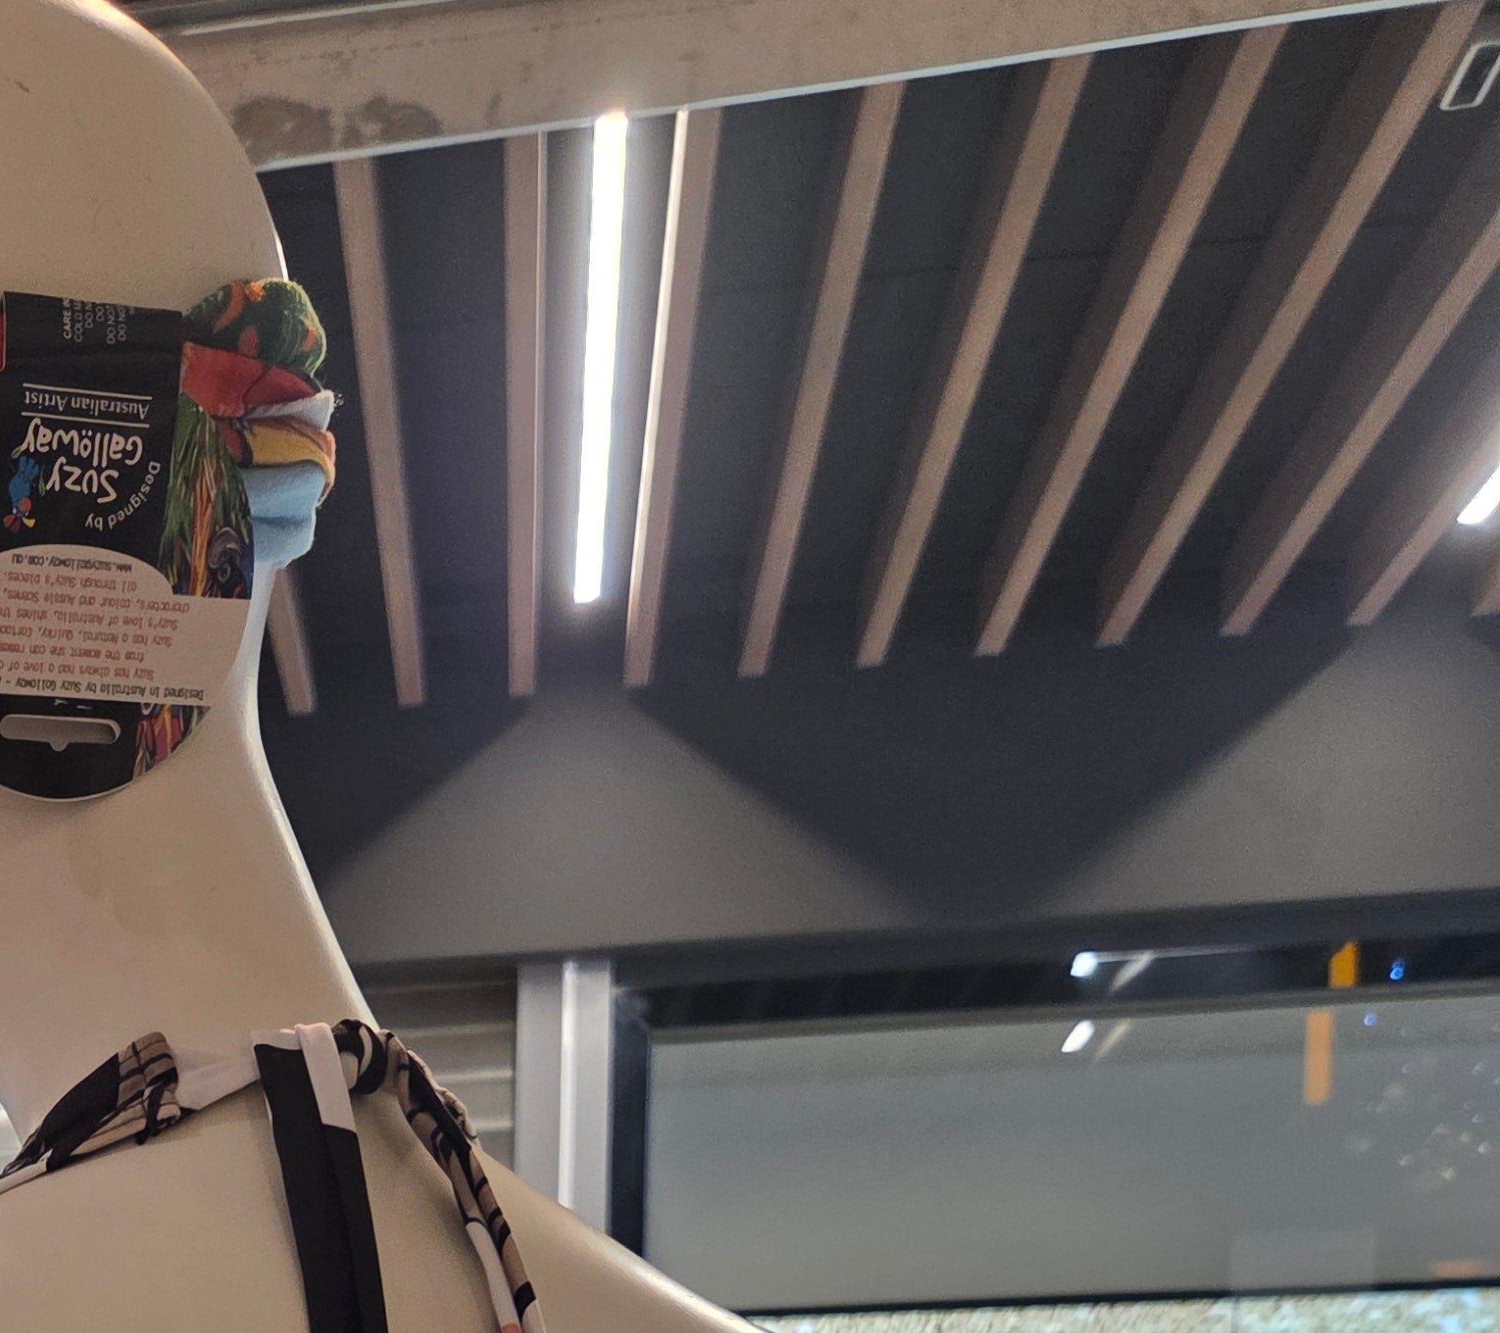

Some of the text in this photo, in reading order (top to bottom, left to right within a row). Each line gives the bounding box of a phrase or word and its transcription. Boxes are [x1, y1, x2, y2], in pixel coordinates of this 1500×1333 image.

[25, 391, 149, 419] Australian Artist
[20, 417, 142, 468] Galloway
[46, 456, 119, 504] Suzy
[85, 460, 161, 531] Designed by
[107, 616, 119, 626] of
[123, 617, 142, 628] love
[122, 634, 128, 642] a
[132, 634, 148, 646] has
[152, 636, 172, 648] Suzy
[105, 650, 120, 661] the
[8, 661, 19, 672] of
[24, 662, 43, 673] love
[49, 663, 54, 672] a
[114, 667, 130, 679] has
[134, 668, 155, 681] Suzy
[16, 677, 56, 691] Galloway
[60, 680, 81, 692] Suzy
[85, 682, 97, 694] by
[100, 684, 146, 697] Australia
[150, 687, 159, 697] in
[164, 688, 204, 700] Designed
